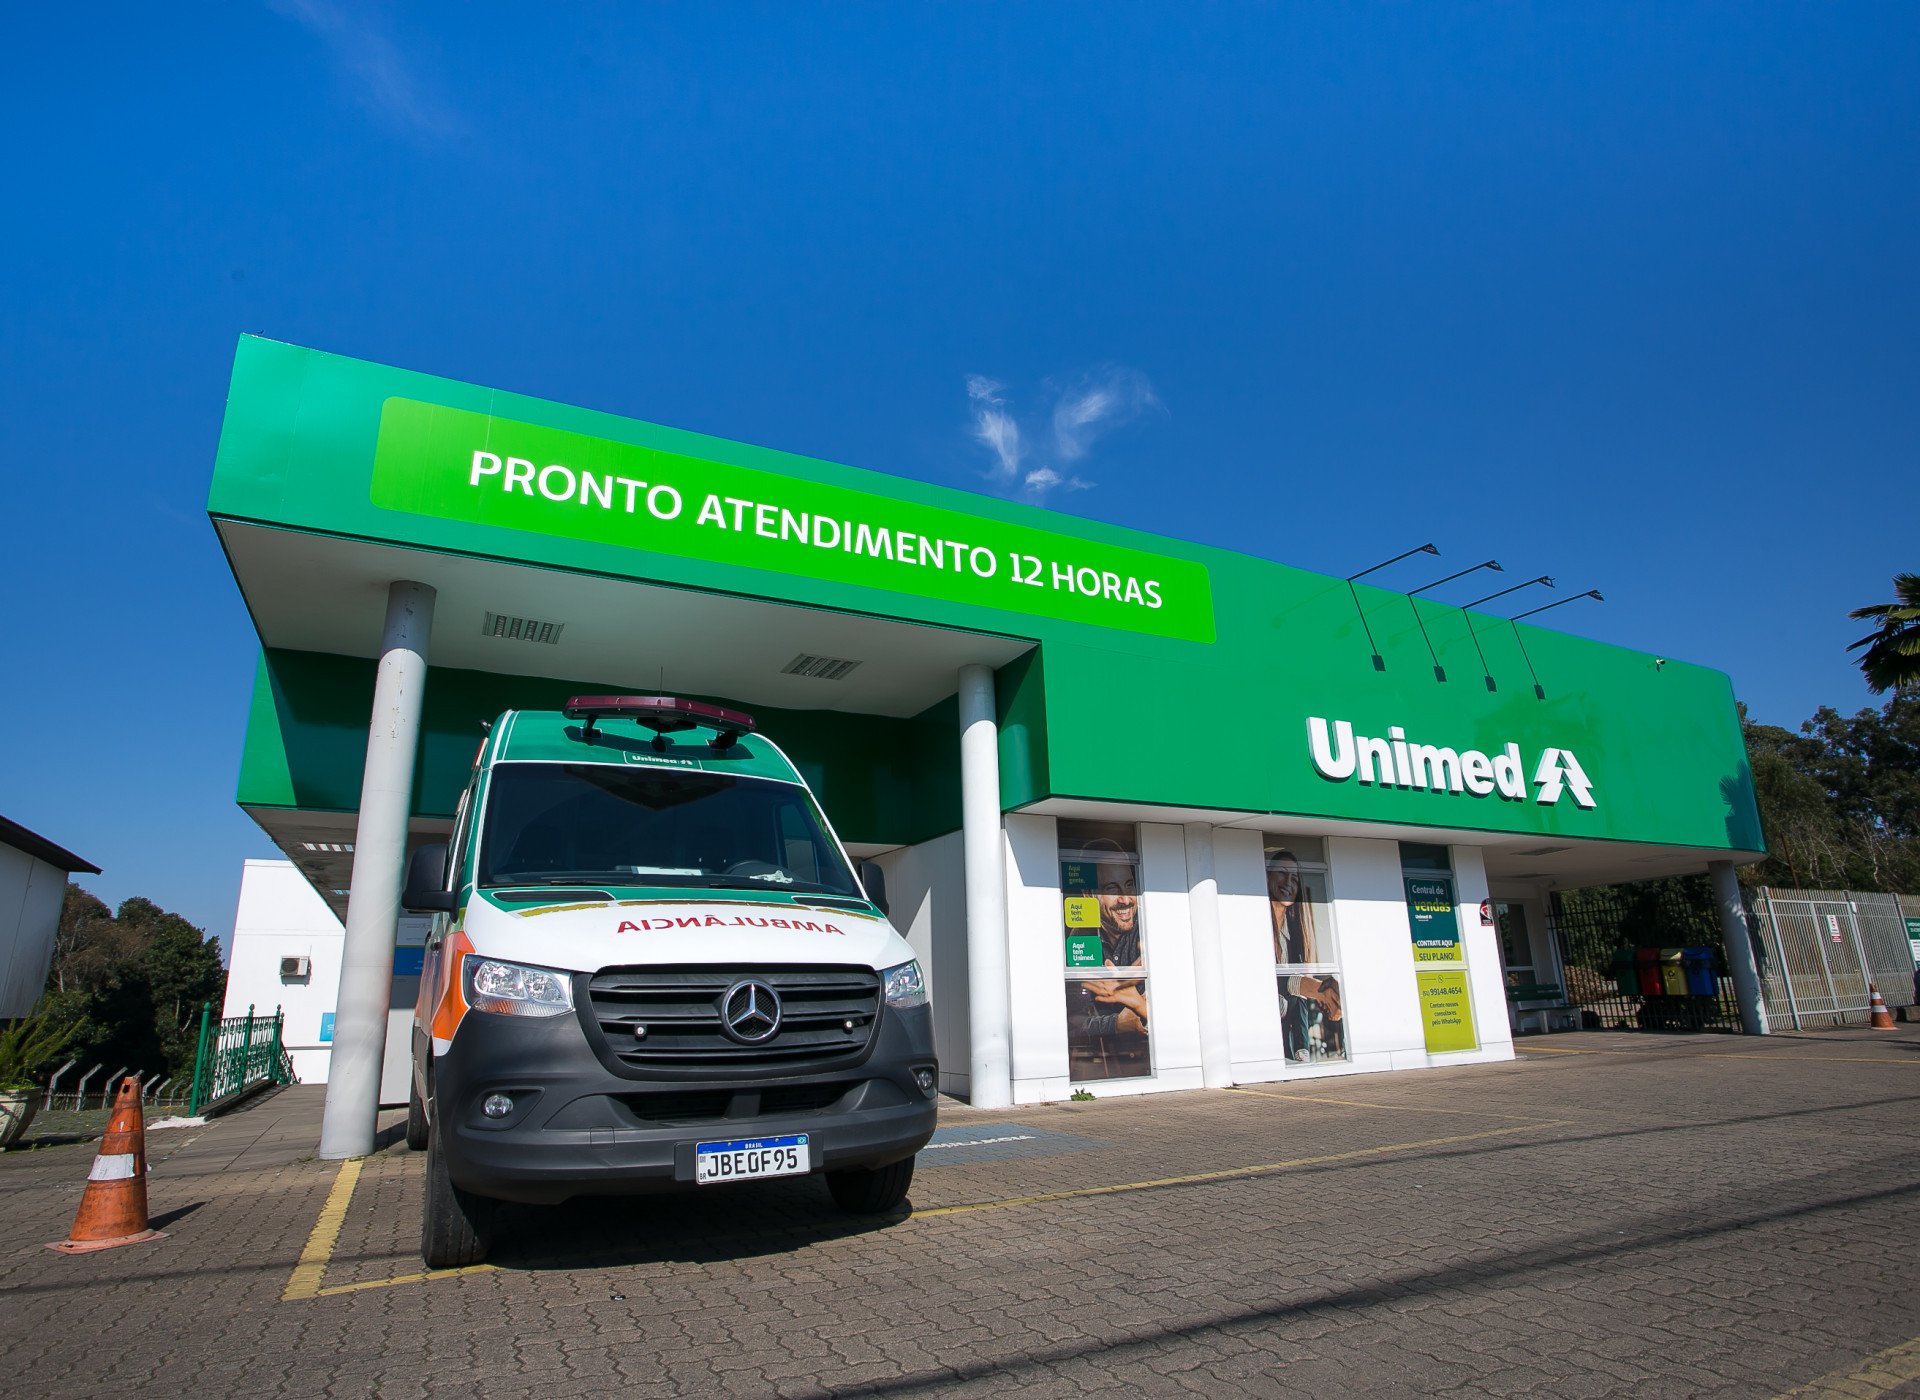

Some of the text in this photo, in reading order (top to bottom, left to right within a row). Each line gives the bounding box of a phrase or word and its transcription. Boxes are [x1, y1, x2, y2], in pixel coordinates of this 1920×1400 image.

[469, 450, 1163, 609] PRONTO ATENDIMENTO 12 HORAS
[632, 755, 677, 764] Unimed
[1306, 716, 1527, 799] Unimed
[1411, 884, 1444, 895] Central de
[1414, 898, 1451, 912] vendas
[1419, 953, 1431, 961] SEU
[1441, 1018, 1461, 1026] WhatsApp
